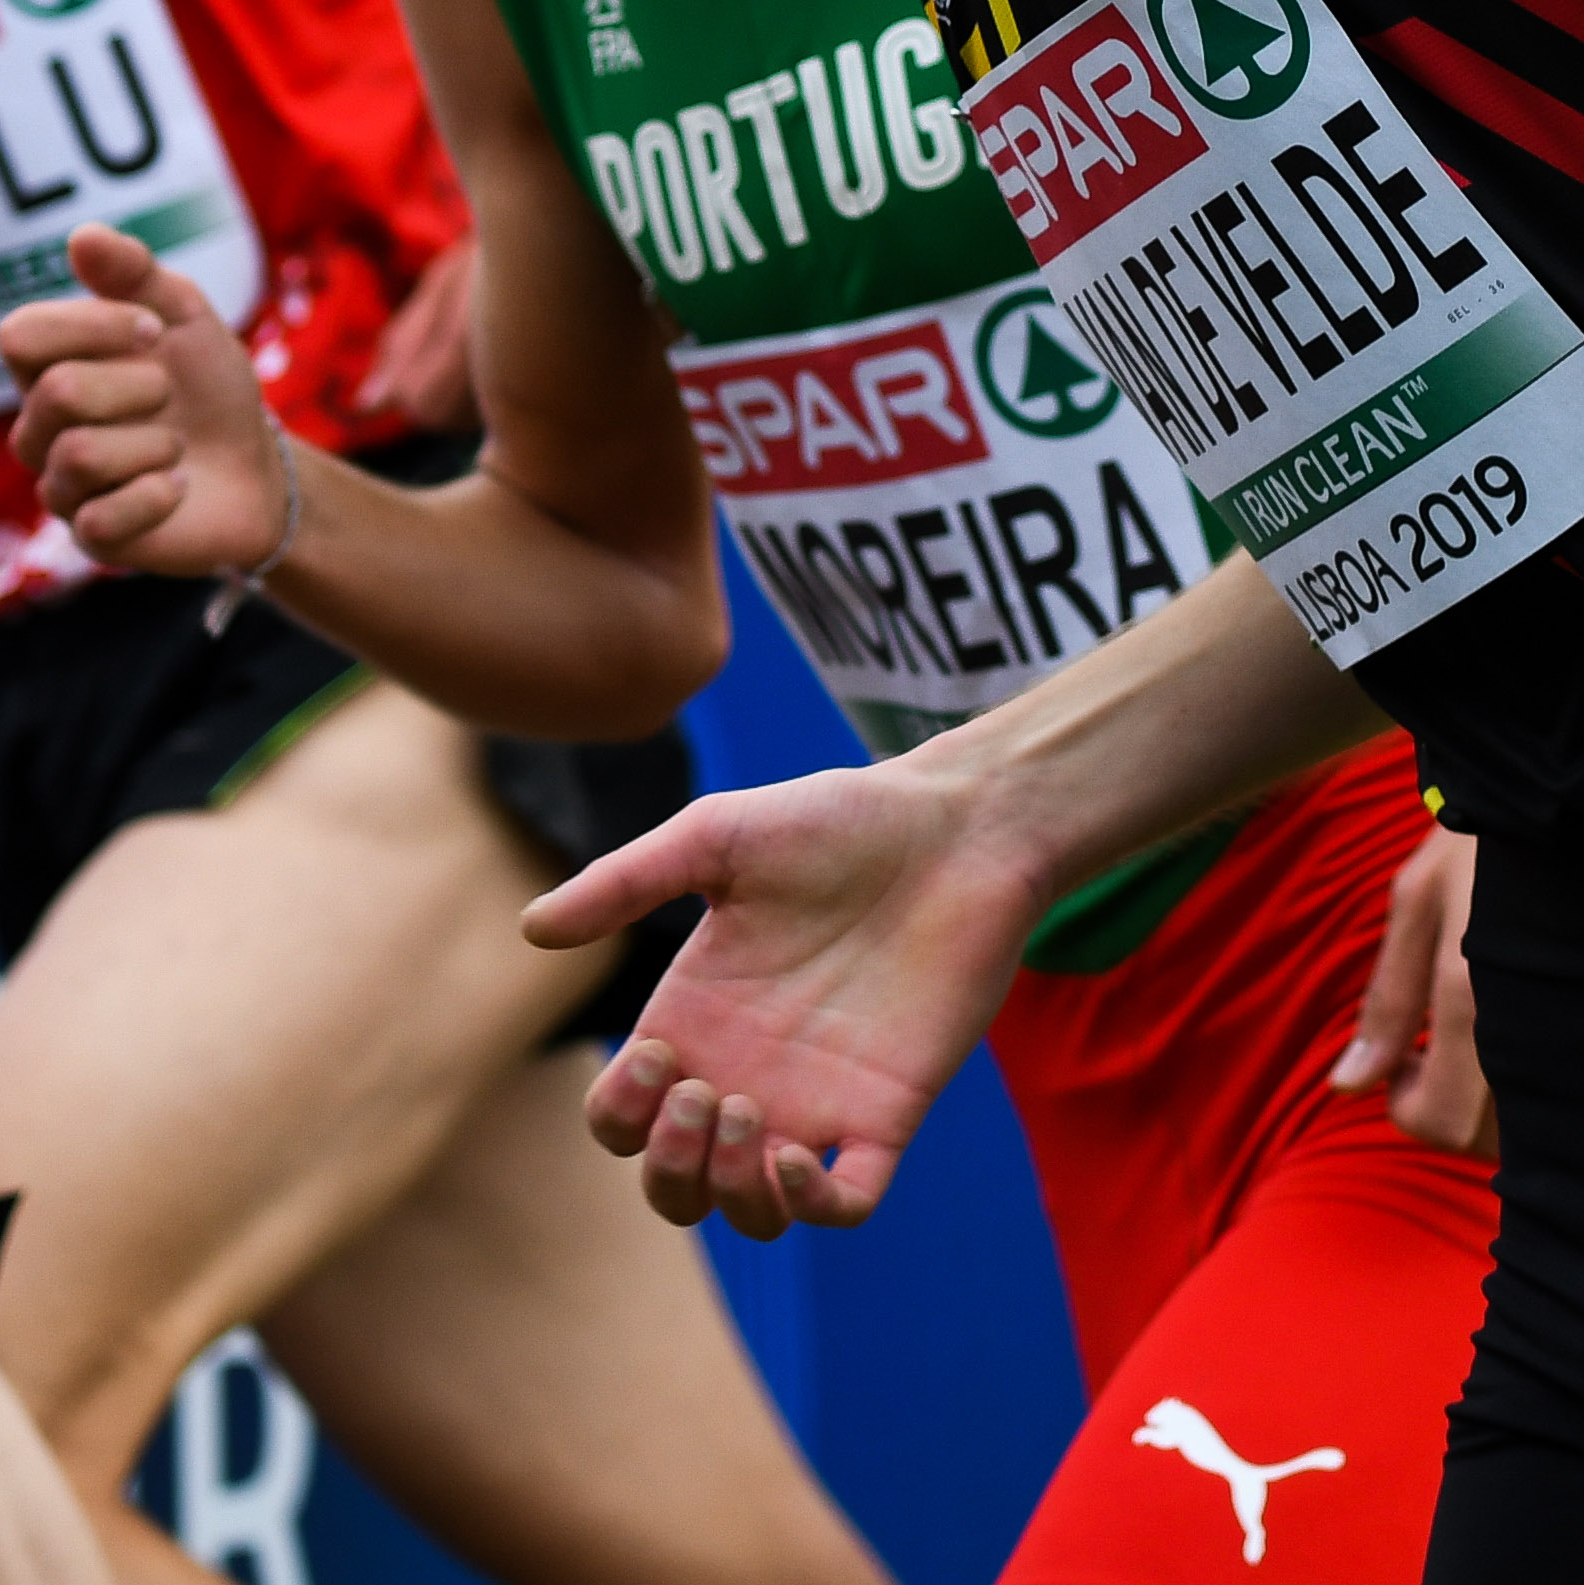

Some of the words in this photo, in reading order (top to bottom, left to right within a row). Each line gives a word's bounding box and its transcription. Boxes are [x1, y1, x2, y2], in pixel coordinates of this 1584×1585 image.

[585, 16, 990, 284] PORTUG
[977, 37, 1182, 241] SPAR
[1120, 236, 1270, 437] DE
[1169, 98, 1489, 397] VELDE
[1447, 305, 1471, 324] BEL
[683, 348, 969, 482] SPAR
[1063, 273, 1217, 466] VAN
[738, 460, 1183, 678] MOREIRA
[1247, 471, 1301, 538] RUN
[1284, 538, 1412, 644] LISBOA
[1390, 454, 1530, 584] 2019
